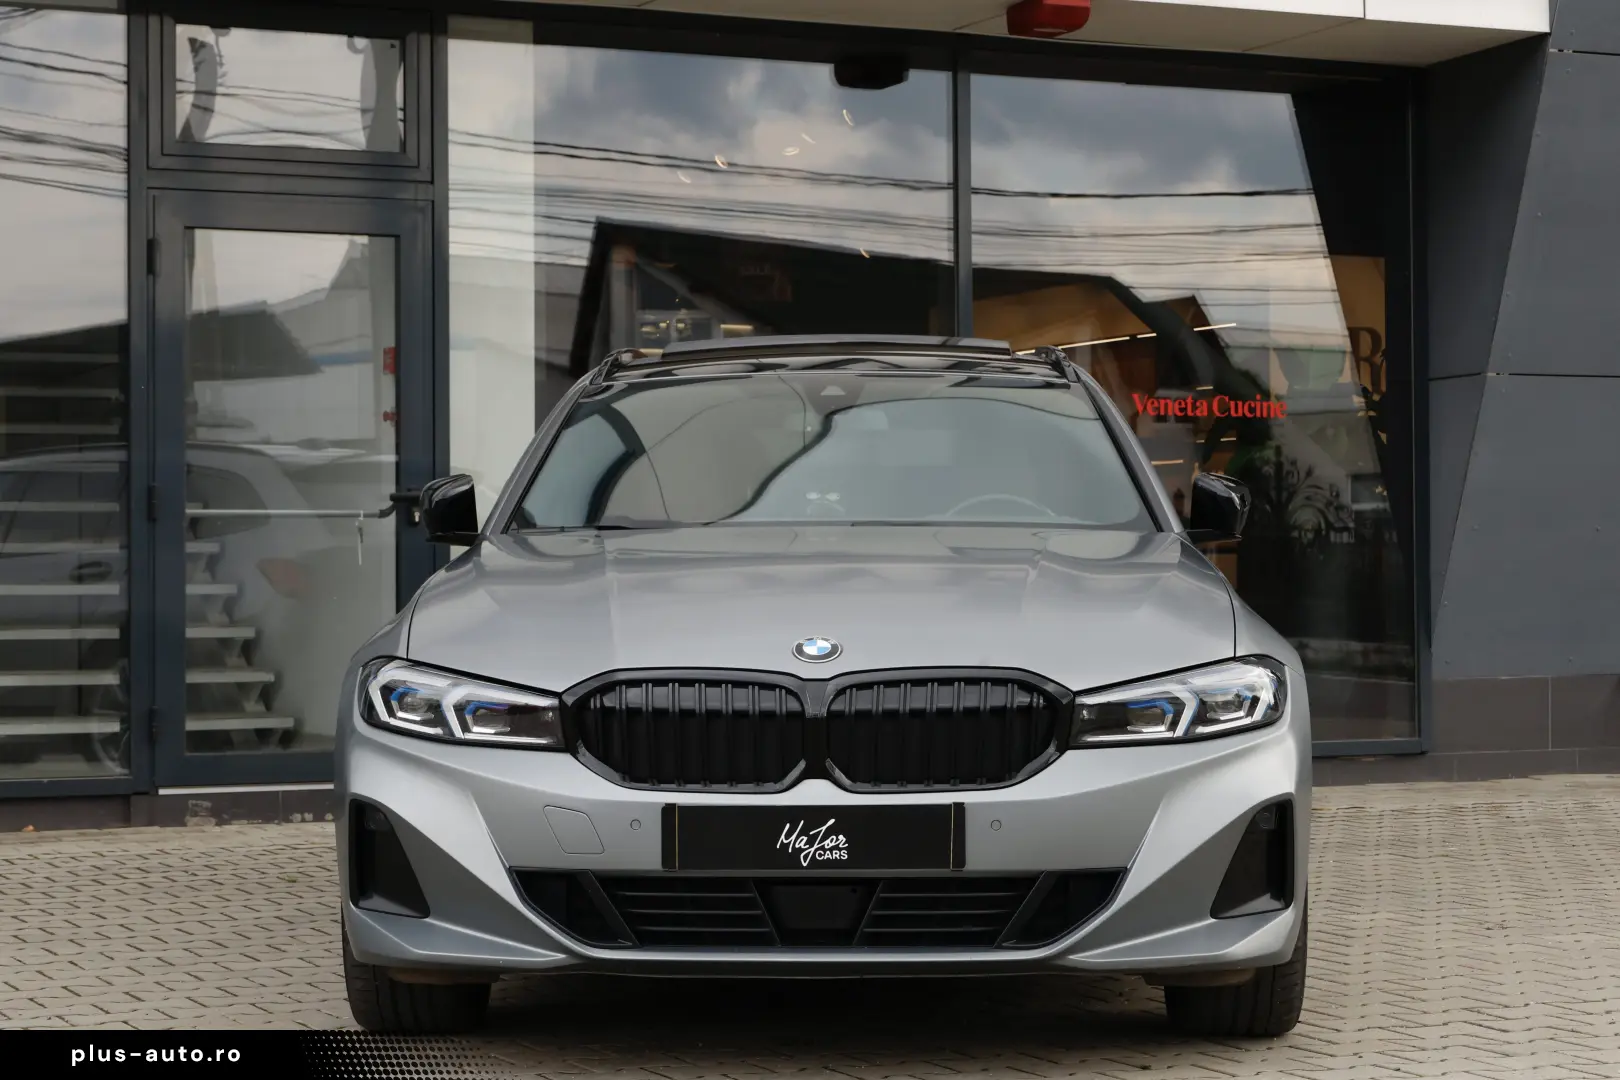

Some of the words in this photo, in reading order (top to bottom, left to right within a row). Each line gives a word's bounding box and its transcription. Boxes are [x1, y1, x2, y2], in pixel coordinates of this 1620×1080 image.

[1131, 393, 1208, 416] Veneta
[1212, 394, 1287, 418] Cucine
[815, 850, 848, 861] CARS
